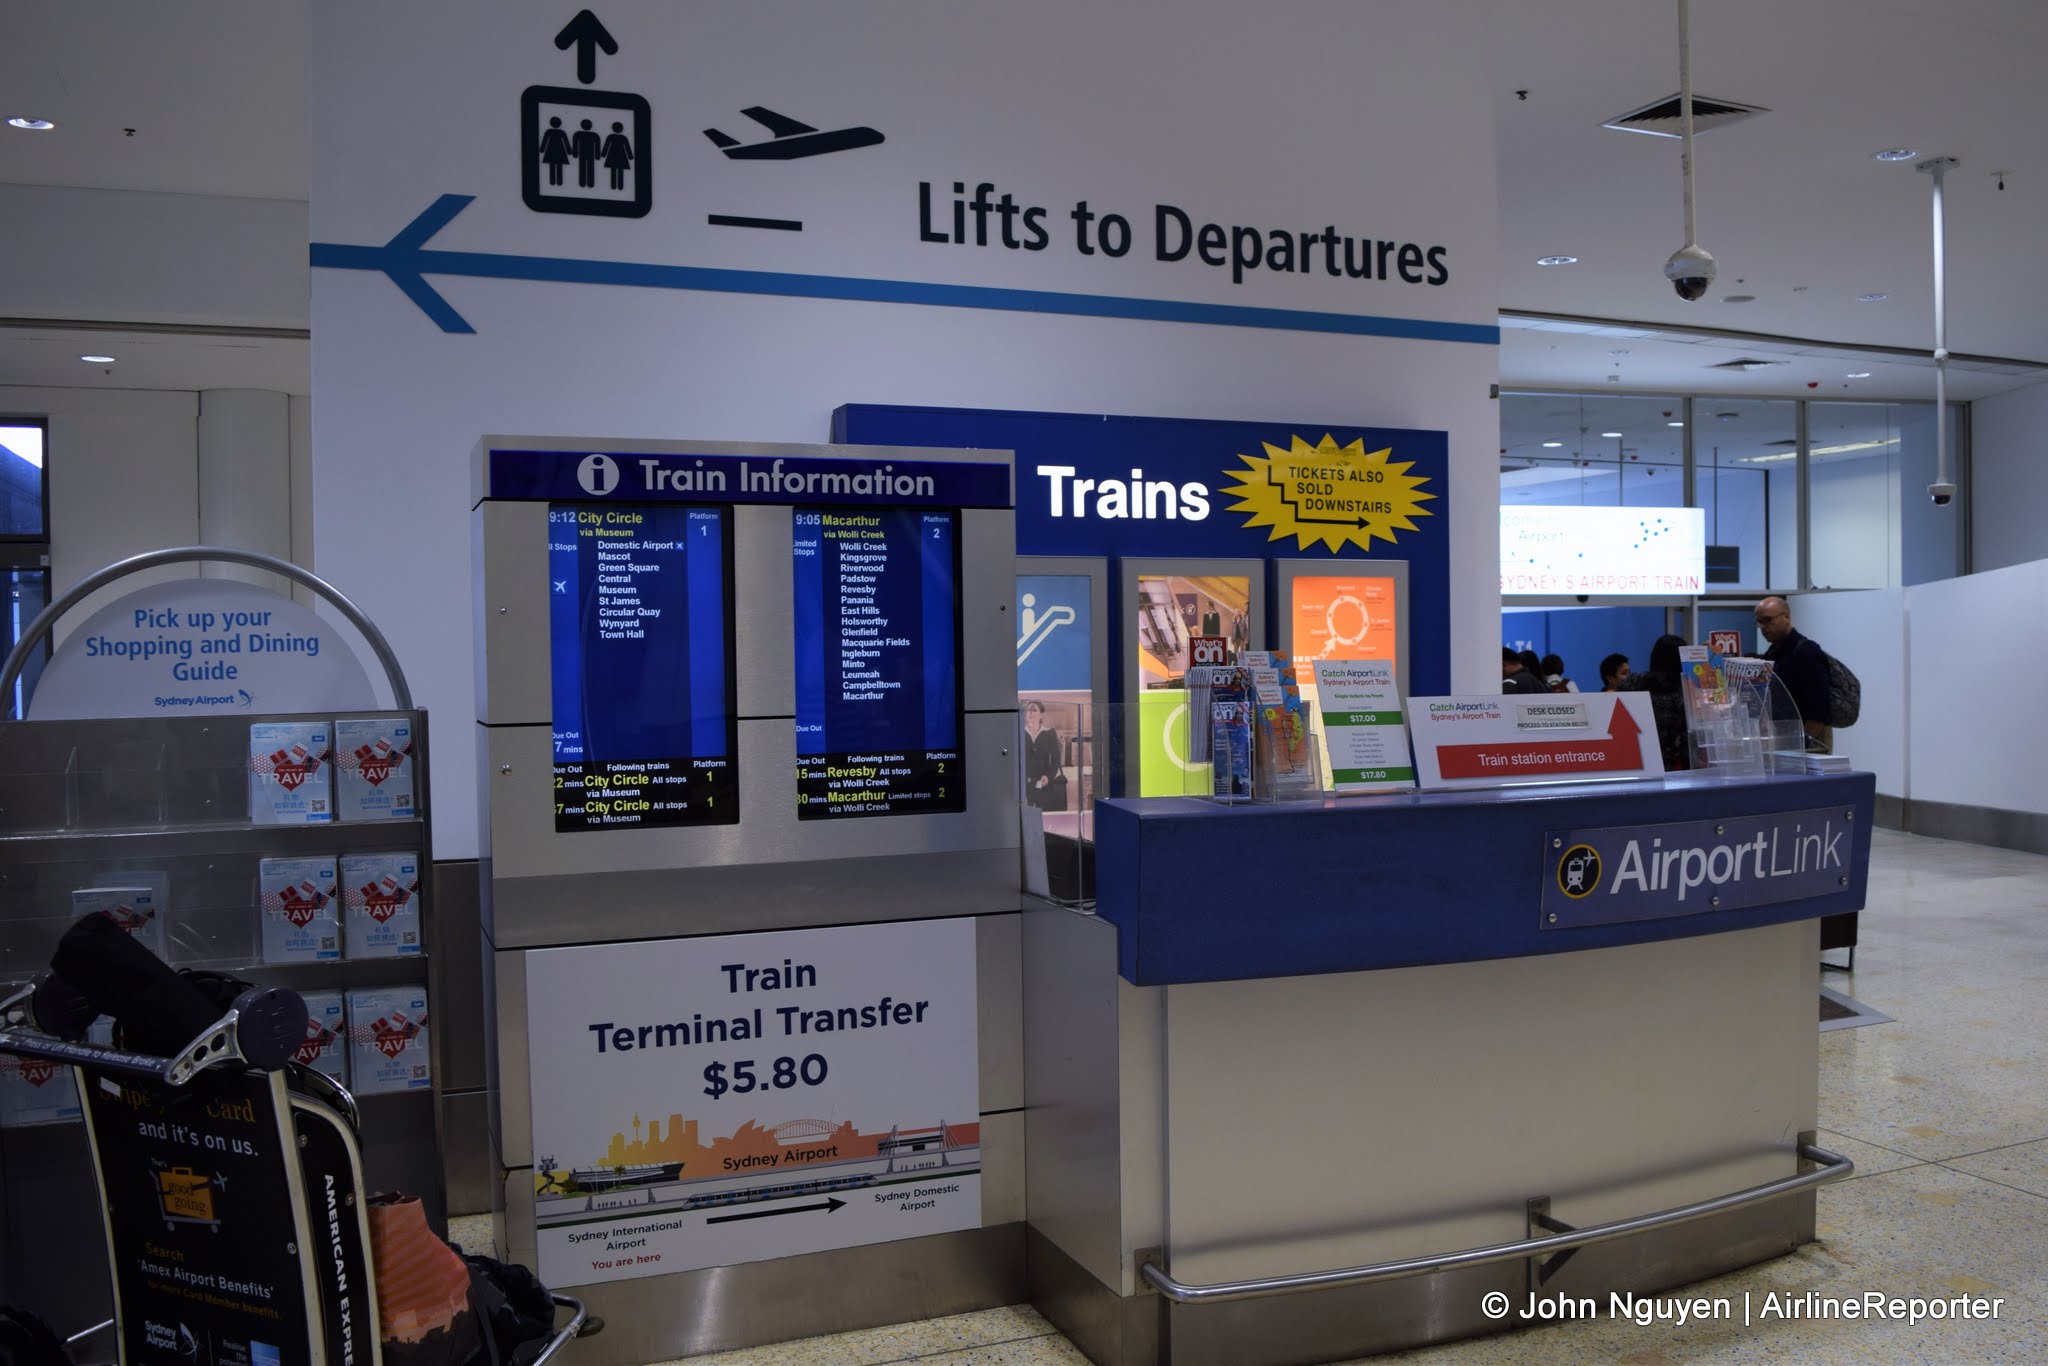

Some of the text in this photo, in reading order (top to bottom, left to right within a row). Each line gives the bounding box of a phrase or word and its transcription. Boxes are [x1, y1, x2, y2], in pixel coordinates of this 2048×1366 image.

[919, 181, 1448, 286] Lifts to Departures
[639, 460, 934, 496] Train Information
[1289, 467, 1383, 482] TICKETS ALSO
[1037, 466, 1210, 521] Trains
[1297, 483, 1333, 495] SOLD
[1306, 499, 1391, 513] DOWNSTAIRS
[549, 512, 643, 525] 9:12 City Circle
[796, 515, 880, 526] 9:05 Macarthur
[598, 541, 673, 551] Domestic Airport
[598, 552, 630, 560] Mascot
[840, 554, 887, 562] Kingsgrove
[598, 564, 659, 573] Green Square
[841, 564, 883, 572] Riverwood
[599, 575, 631, 583] Central
[1581, 575, 1699, 589] AIRPORT TRAIN
[599, 586, 636, 594] Museum
[841, 585, 876, 595] Revesby
[611, 597, 640, 605] James
[841, 596, 873, 604] Panania
[599, 608, 660, 618] Circular Quay
[135, 608, 271, 632] Pick up your
[600, 619, 639, 629] Wynyard
[842, 618, 888, 626] Holsworthy
[600, 630, 644, 639] Town Hall
[842, 628, 877, 636] Glenfield
[86, 633, 319, 660] Shopping and Dining
[842, 638, 910, 648] Macquarie Fields
[842, 649, 880, 659] Ingleburn
[1194, 647, 1223, 662] on
[173, 660, 237, 681] Guide
[1347, 670, 1388, 678] AirportLink
[1746, 668, 1760, 677] on
[843, 681, 900, 690] Campbelltown
[1213, 675, 1231, 684] on
[155, 695, 234, 707] Sydney Airport
[843, 692, 884, 700] Macarthur
[1430, 702, 1499, 712] Catch AirportLink
[1527, 707, 1575, 716] DESK CLOSED
[1431, 713, 1461, 722] Sydney's
[1462, 712, 1484, 720] Airport
[693, 760, 726, 768] Platform
[1478, 751, 1605, 766] Train station entrance
[344, 768, 408, 779] TRAVEL
[607, 763, 645, 772] Following
[828, 766, 876, 778] Revesby
[260, 773, 323, 784] TRAVEL
[585, 774, 649, 788] City Circle
[1361, 771, 1386, 779] $17.80
[602, 789, 640, 797] Museum
[828, 791, 885, 802] Macarthur
[586, 800, 649, 814] City Circle
[603, 815, 641, 823] Museum
[1609, 821, 1843, 901] AirportLink
[270, 909, 331, 921] TRAVEL
[352, 904, 412, 917] TRAVEL
[721, 959, 816, 993] Train
[589, 997, 929, 1053] Terminal Transfer
[361, 1039, 423, 1052] TRAVEL
[23, 1038, 42, 1048] Press
[52, 1042, 64, 1050] Lift
[93, 1050, 100, 1058] to
[101, 1051, 131, 1063] Release
[131, 1055, 155, 1066] Brake
[292, 1046, 338, 1059] AVEL
[703, 1053, 828, 1099] $5.80
[138, 1121, 259, 1156] and it's on us.
[723, 1145, 838, 1171] Sydney Airport
[168, 1183, 194, 1196] good
[874, 1183, 960, 1204] Sydney Domestic
[174, 1196, 207, 1215] going
[900, 1199, 935, 1214] Airport
[325, 1174, 347, 1292] AMERICAN
[567, 1220, 682, 1245] Sydney International
[144, 1241, 184, 1262] Search
[606, 1238, 646, 1253] Airport
[591, 1253, 662, 1271] You are here
[138, 1258, 274, 1299] 'Amex Airport Benefits'
[145, 1320, 176, 1339] Sydney
[146, 1335, 177, 1351] Airport
